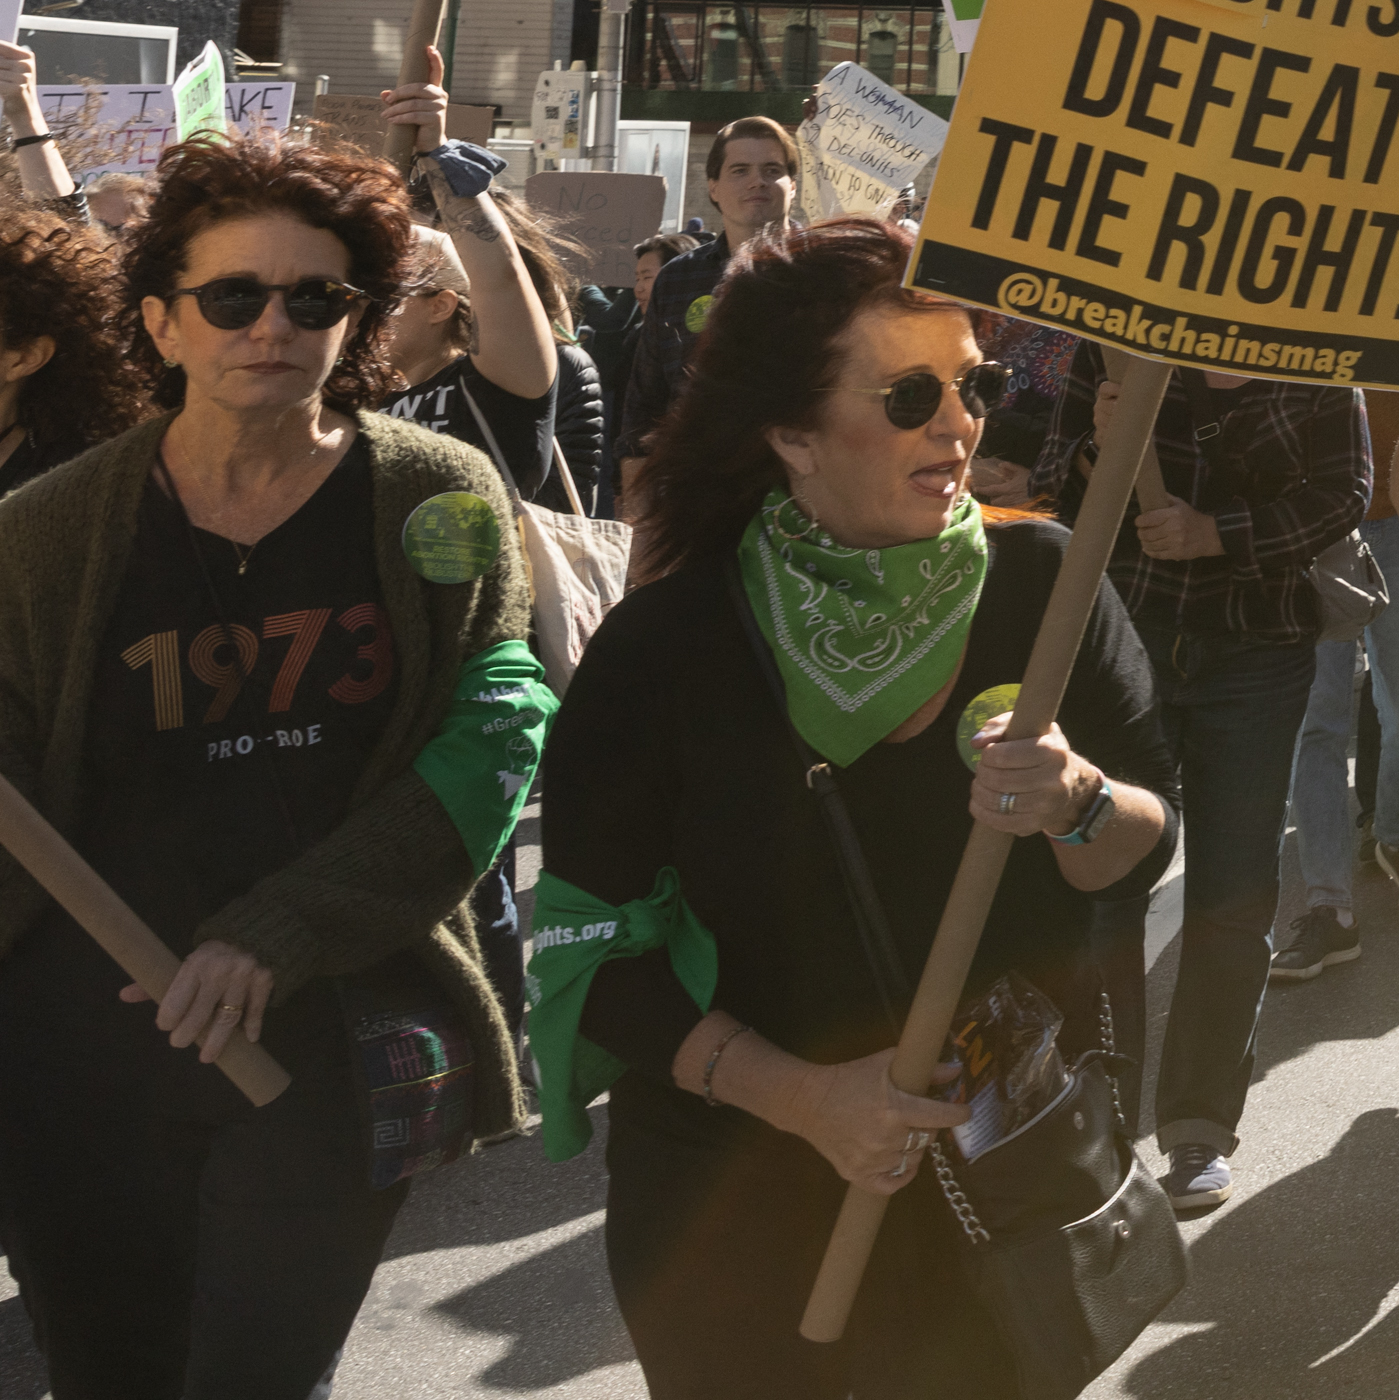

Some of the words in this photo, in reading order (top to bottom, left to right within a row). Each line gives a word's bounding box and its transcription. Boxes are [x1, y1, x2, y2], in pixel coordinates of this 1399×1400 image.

[828, 66, 850, 86] A
[855, 78, 924, 130] WOMAN
[970, 116, 1149, 268] THE
[997, 271, 1362, 383] @breakchainsmag
[120, 602, 394, 732] 1973
